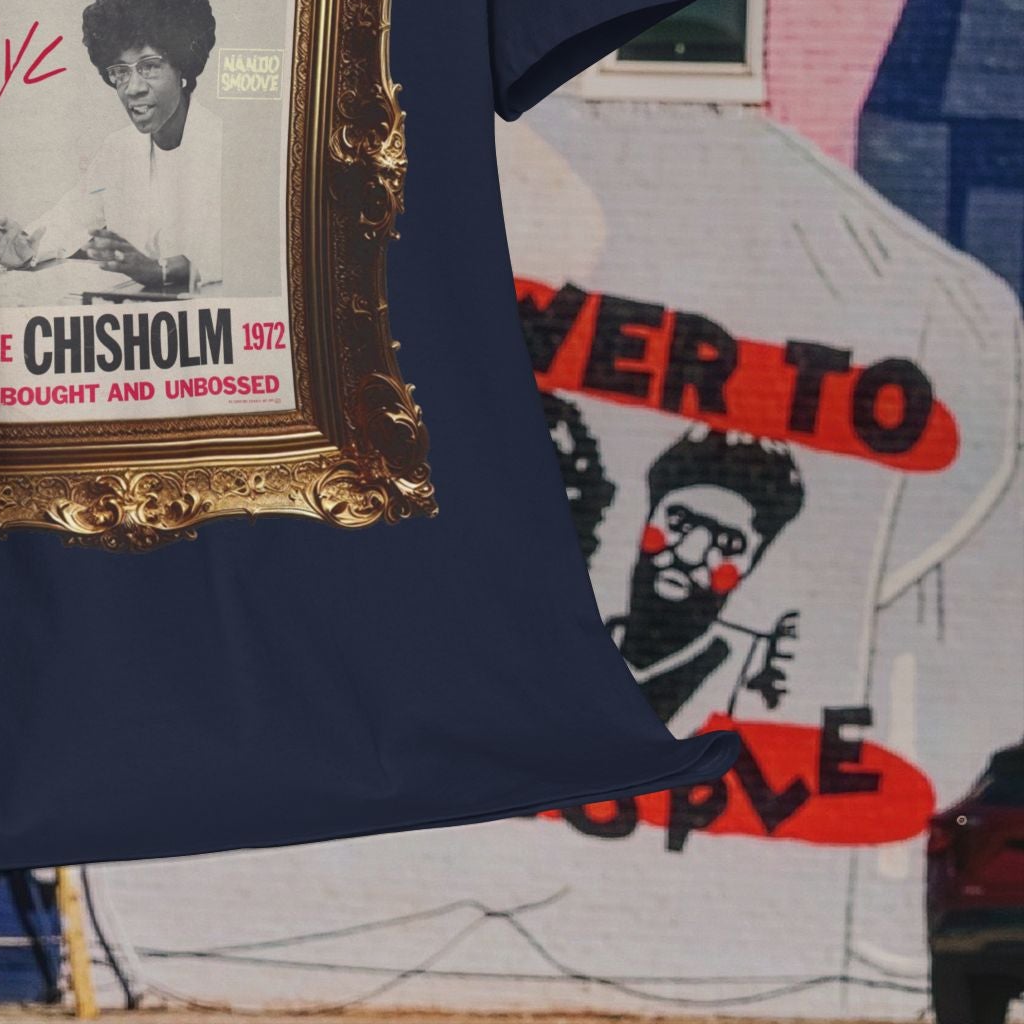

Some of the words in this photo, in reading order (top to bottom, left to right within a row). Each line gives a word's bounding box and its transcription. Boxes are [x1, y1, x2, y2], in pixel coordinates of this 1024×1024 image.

[223, 54, 280, 74] NANDO
[221, 72, 279, 92] SMOOVE
[23, 308, 234, 376] CHISHOLM
[242, 321, 287, 351] 1972
[107, 381, 155, 402] AND
[164, 374, 280, 399] UNBOSSED
[785, 340, 933, 454] TO
